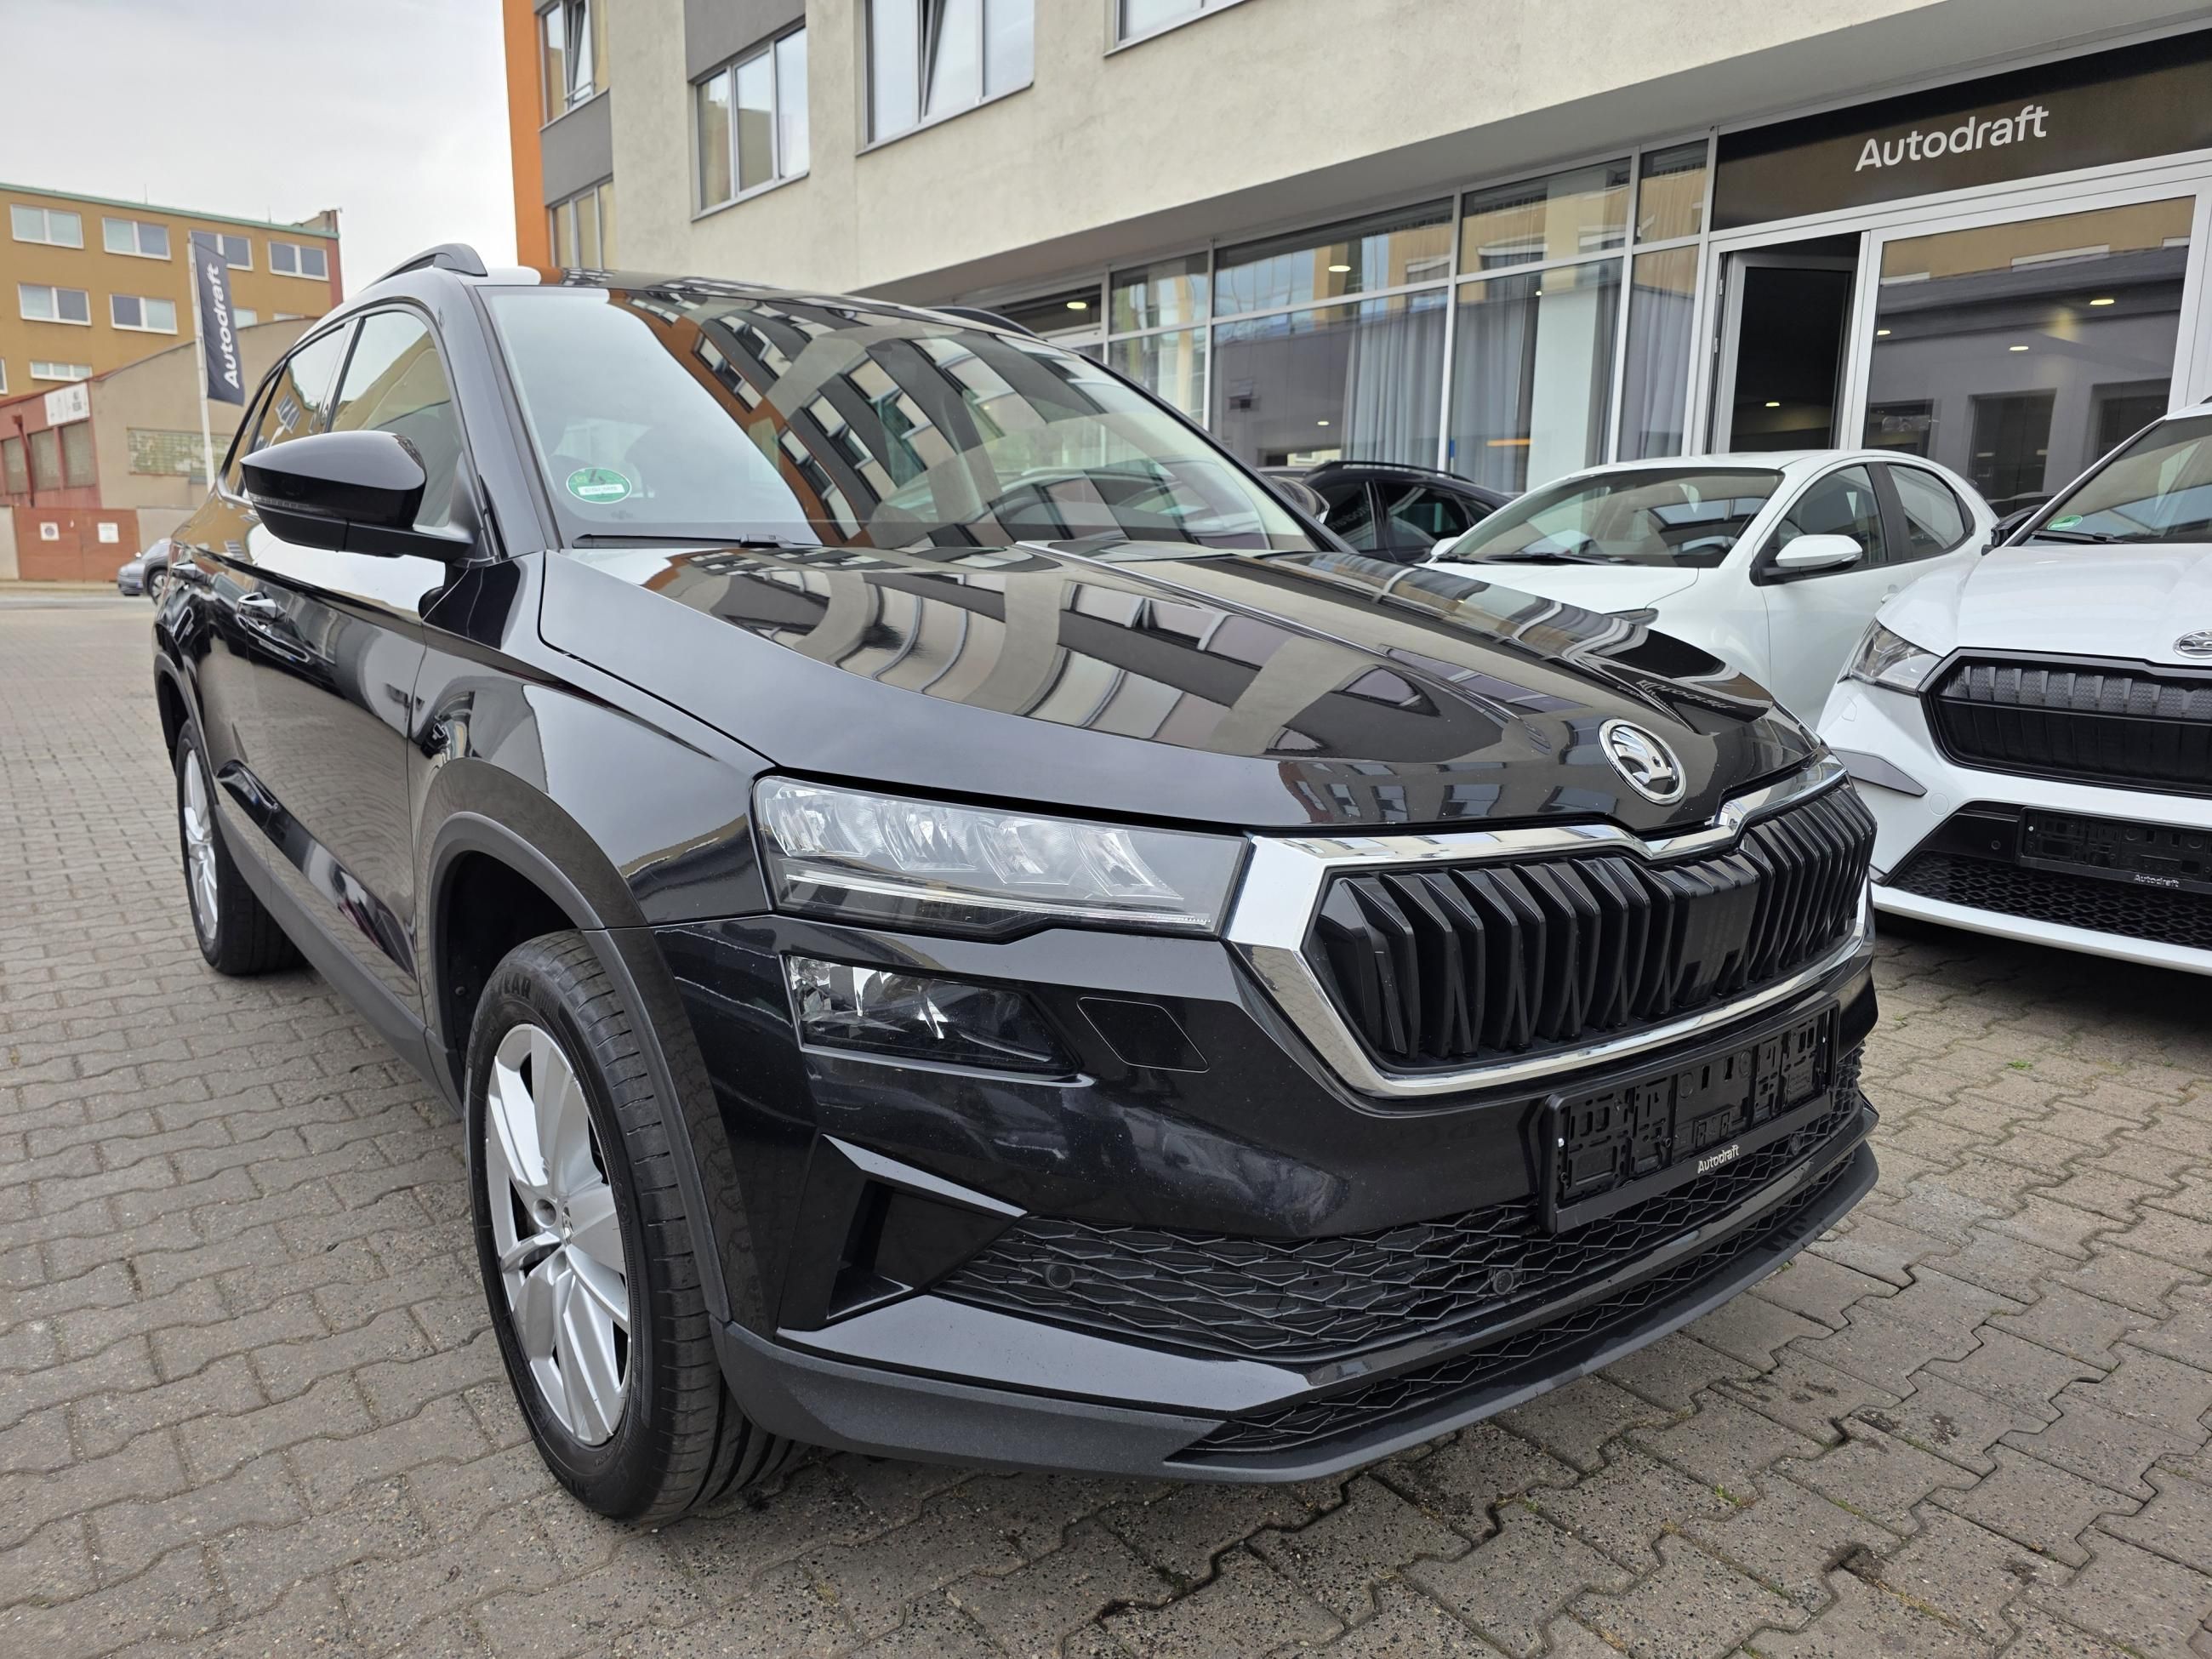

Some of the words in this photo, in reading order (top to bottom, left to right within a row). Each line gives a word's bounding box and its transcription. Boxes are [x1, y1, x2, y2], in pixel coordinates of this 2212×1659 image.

[1855, 105, 2050, 172] Autodraft
[206, 262, 240, 390] Autodraft
[1697, 1144, 1739, 1174] Autodraft
